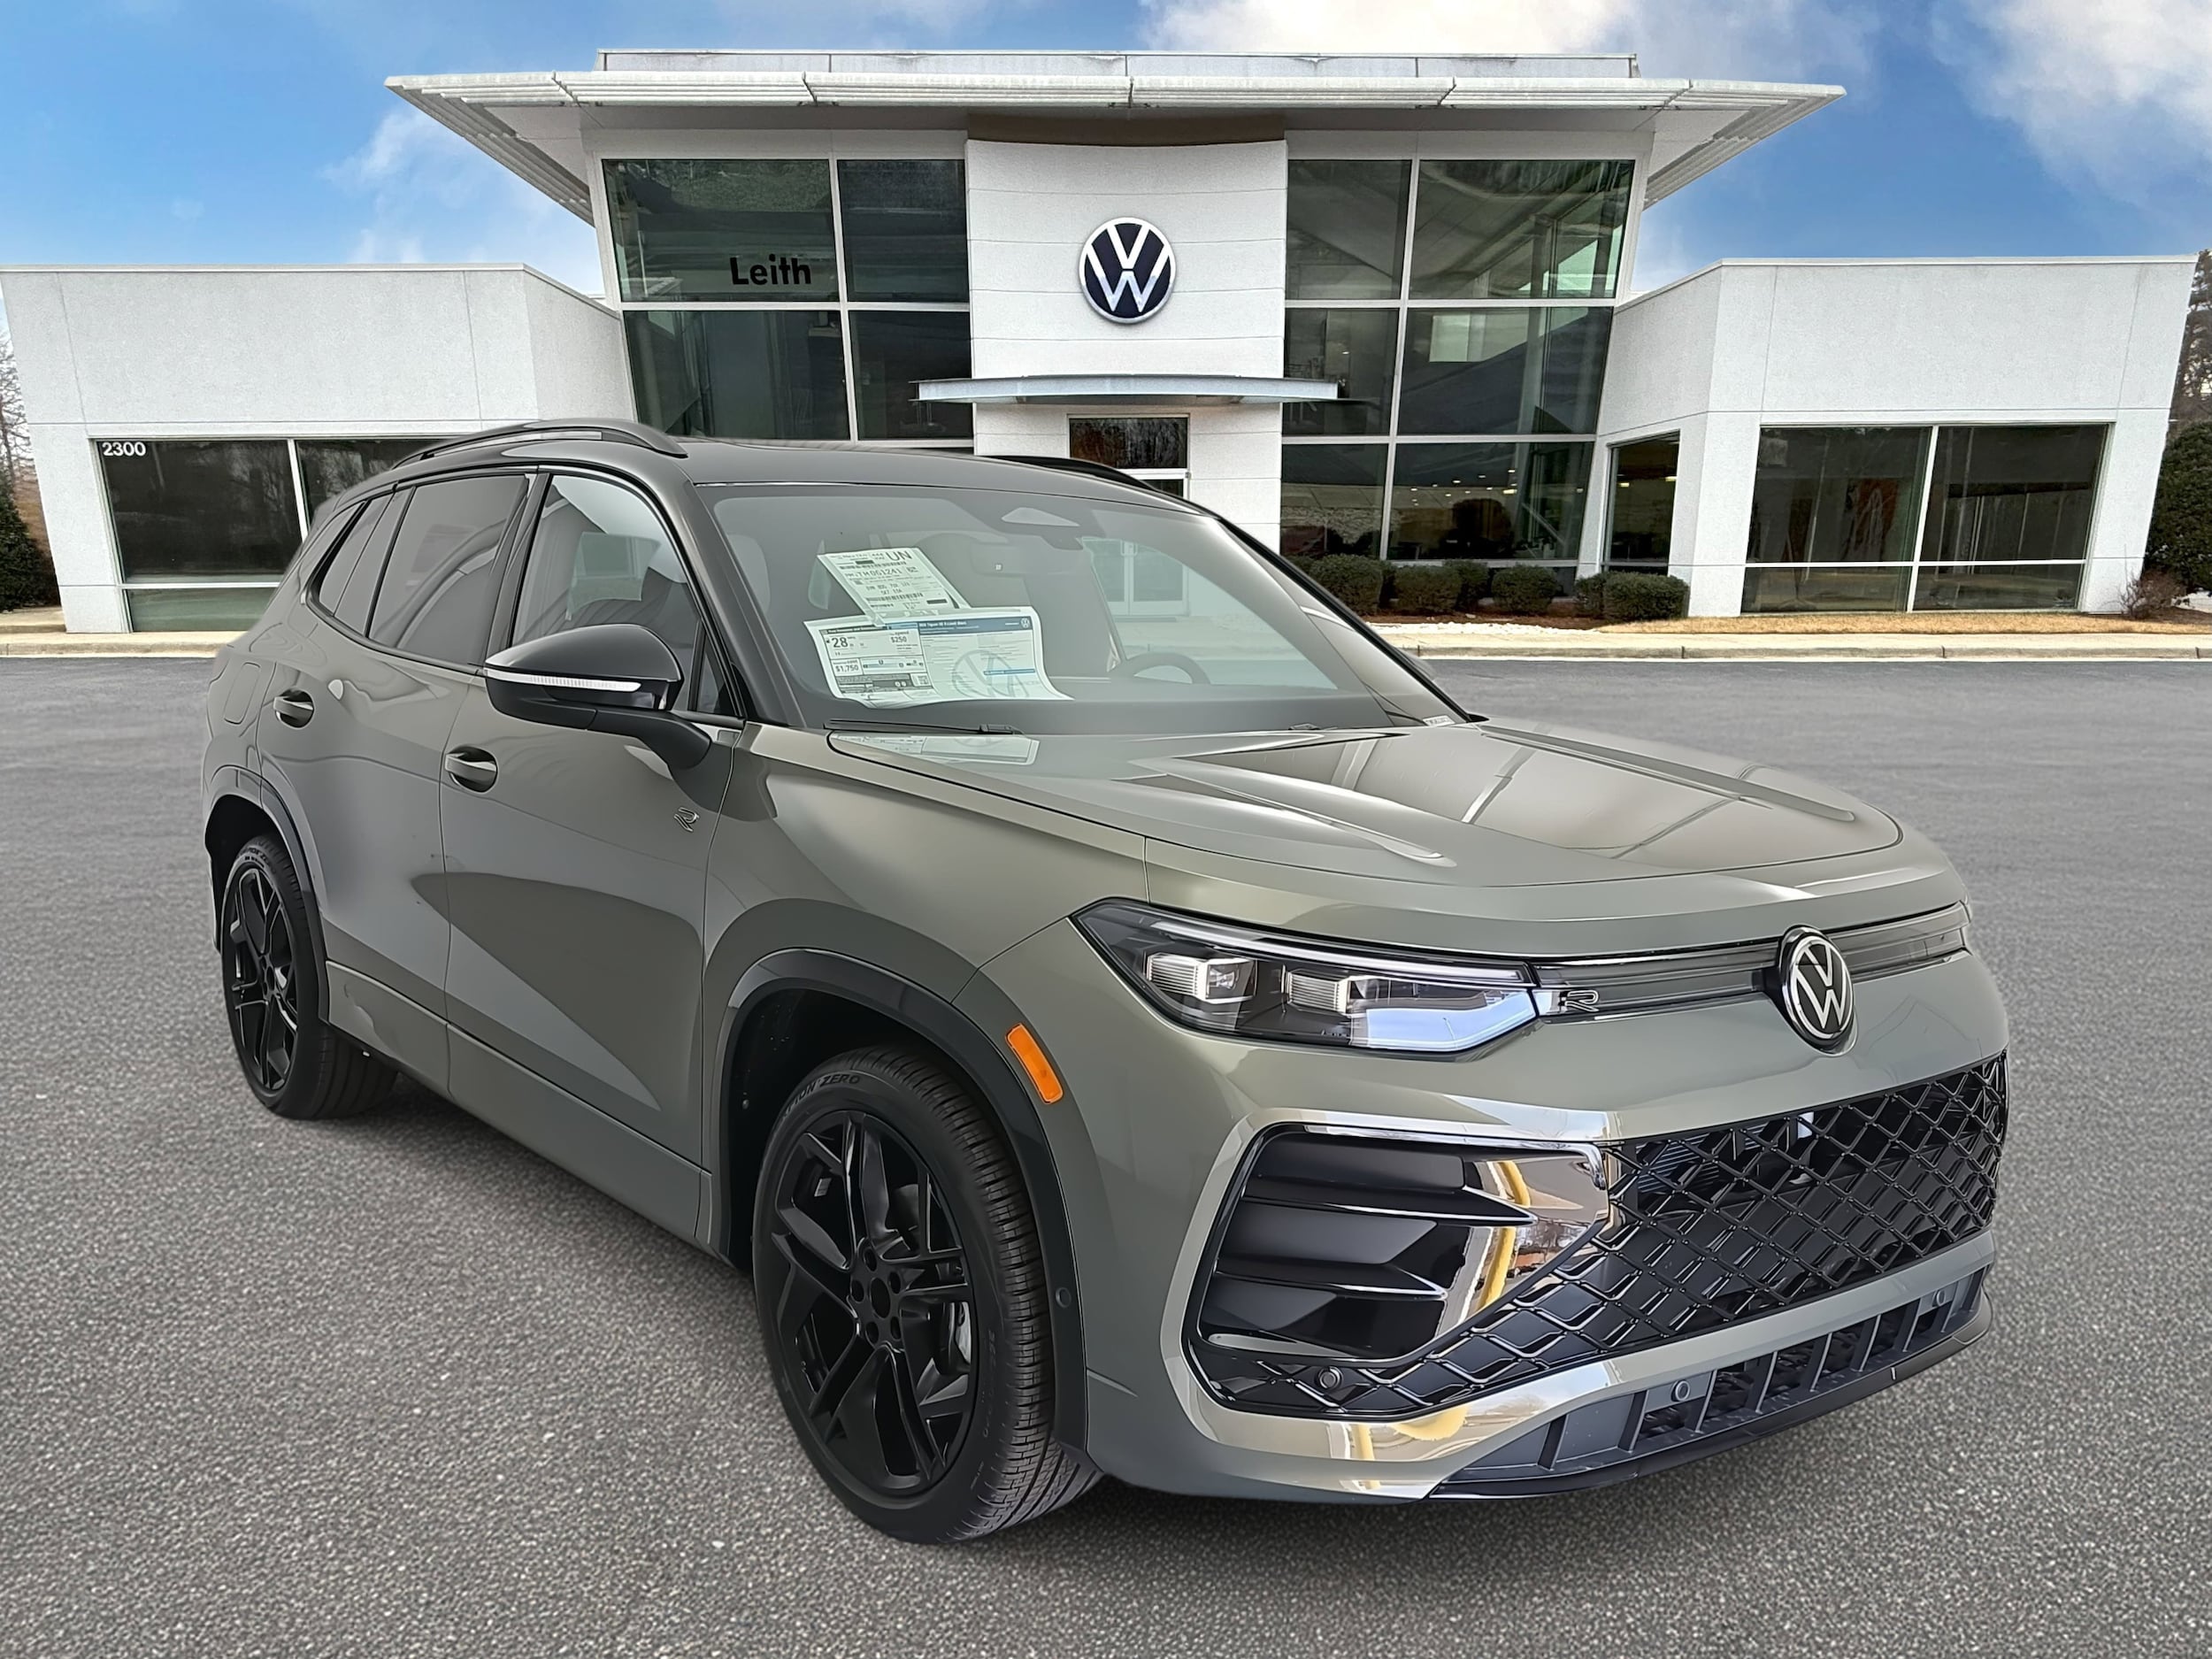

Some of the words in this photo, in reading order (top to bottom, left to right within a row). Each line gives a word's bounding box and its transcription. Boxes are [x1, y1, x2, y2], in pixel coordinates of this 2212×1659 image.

[729, 253, 812, 285] Leith
[1080, 219, 1174, 319] VW
[102, 442, 147, 457] 2300
[885, 550, 912, 561] UN
[832, 636, 849, 649] 28
[1790, 937, 1852, 1035] VW
